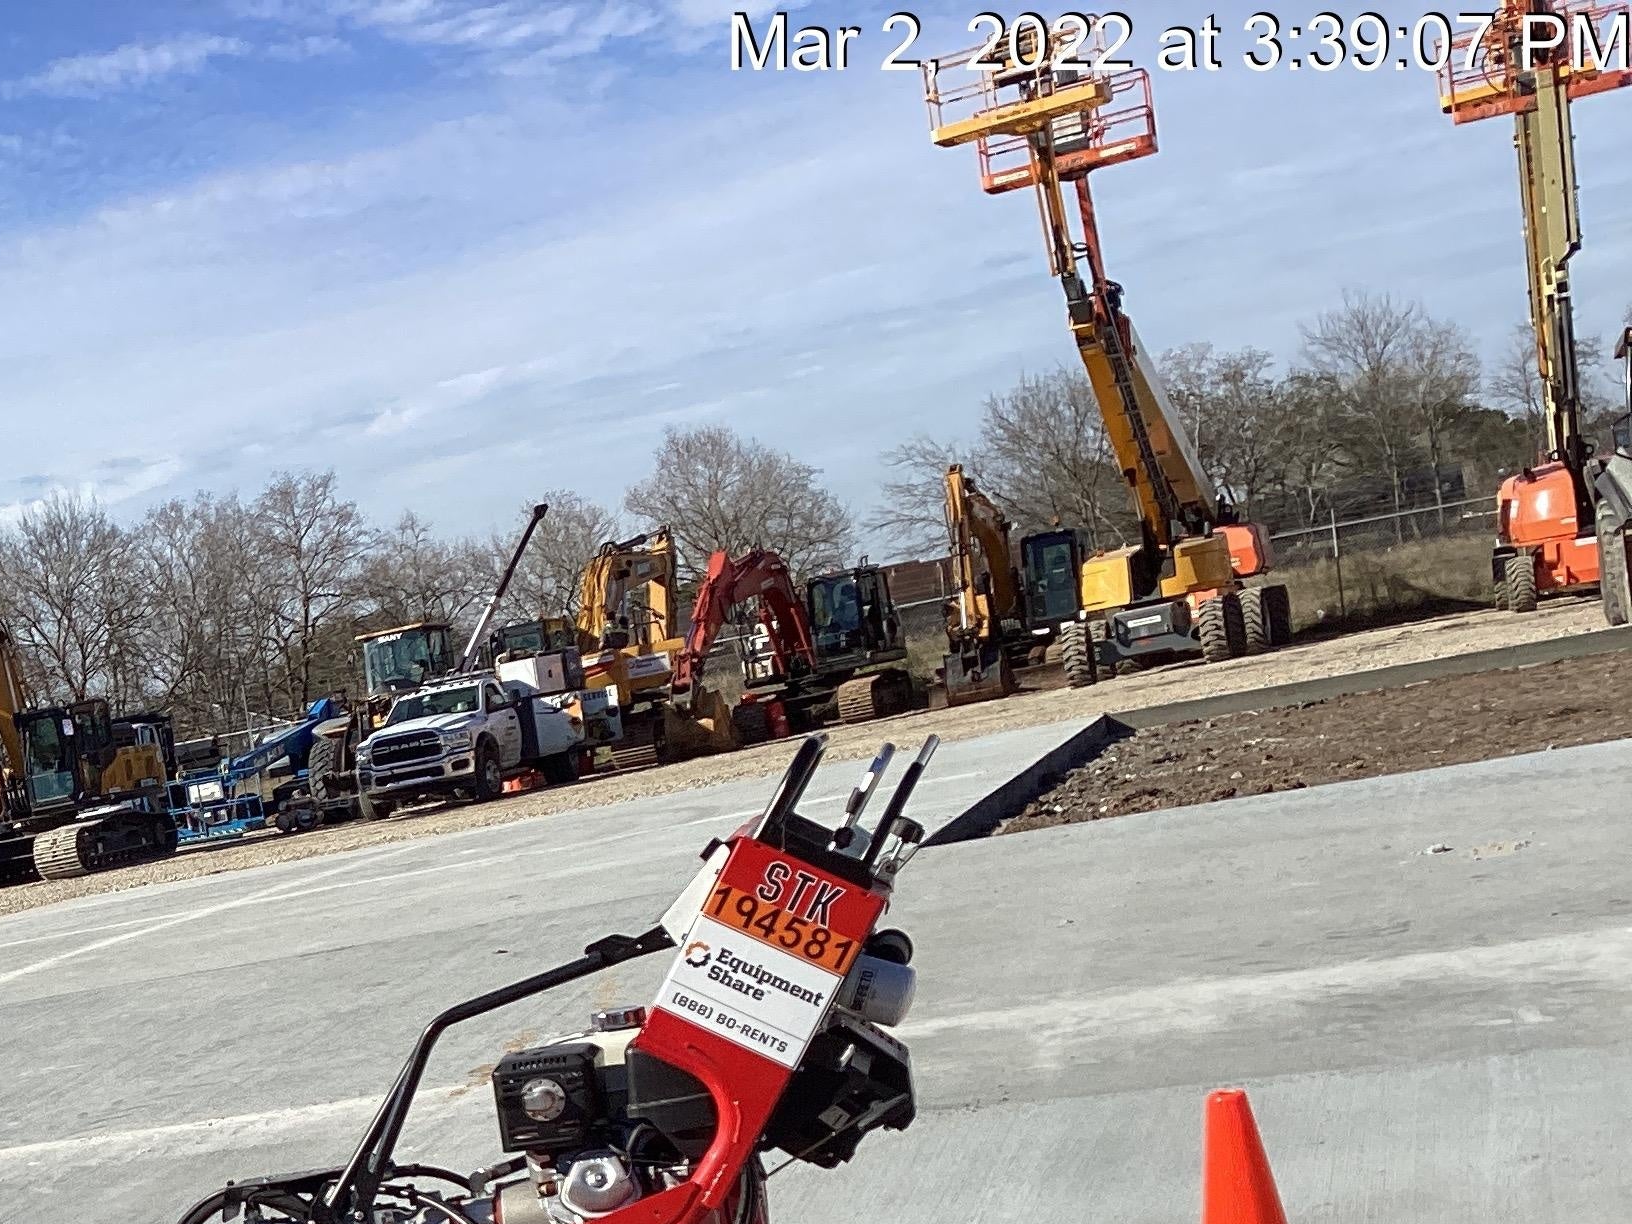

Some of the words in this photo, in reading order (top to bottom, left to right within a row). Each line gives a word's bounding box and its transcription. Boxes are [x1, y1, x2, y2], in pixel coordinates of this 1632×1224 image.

[390, 741, 420, 751] RAM
[756, 860, 846, 930] STK
[714, 886, 853, 970] 194581
[706, 963, 766, 1002] Share
[715, 946, 825, 1008] Equipment
[671, 991, 715, 1020] (888)
[715, 1012, 789, 1053] 80-RENTS
